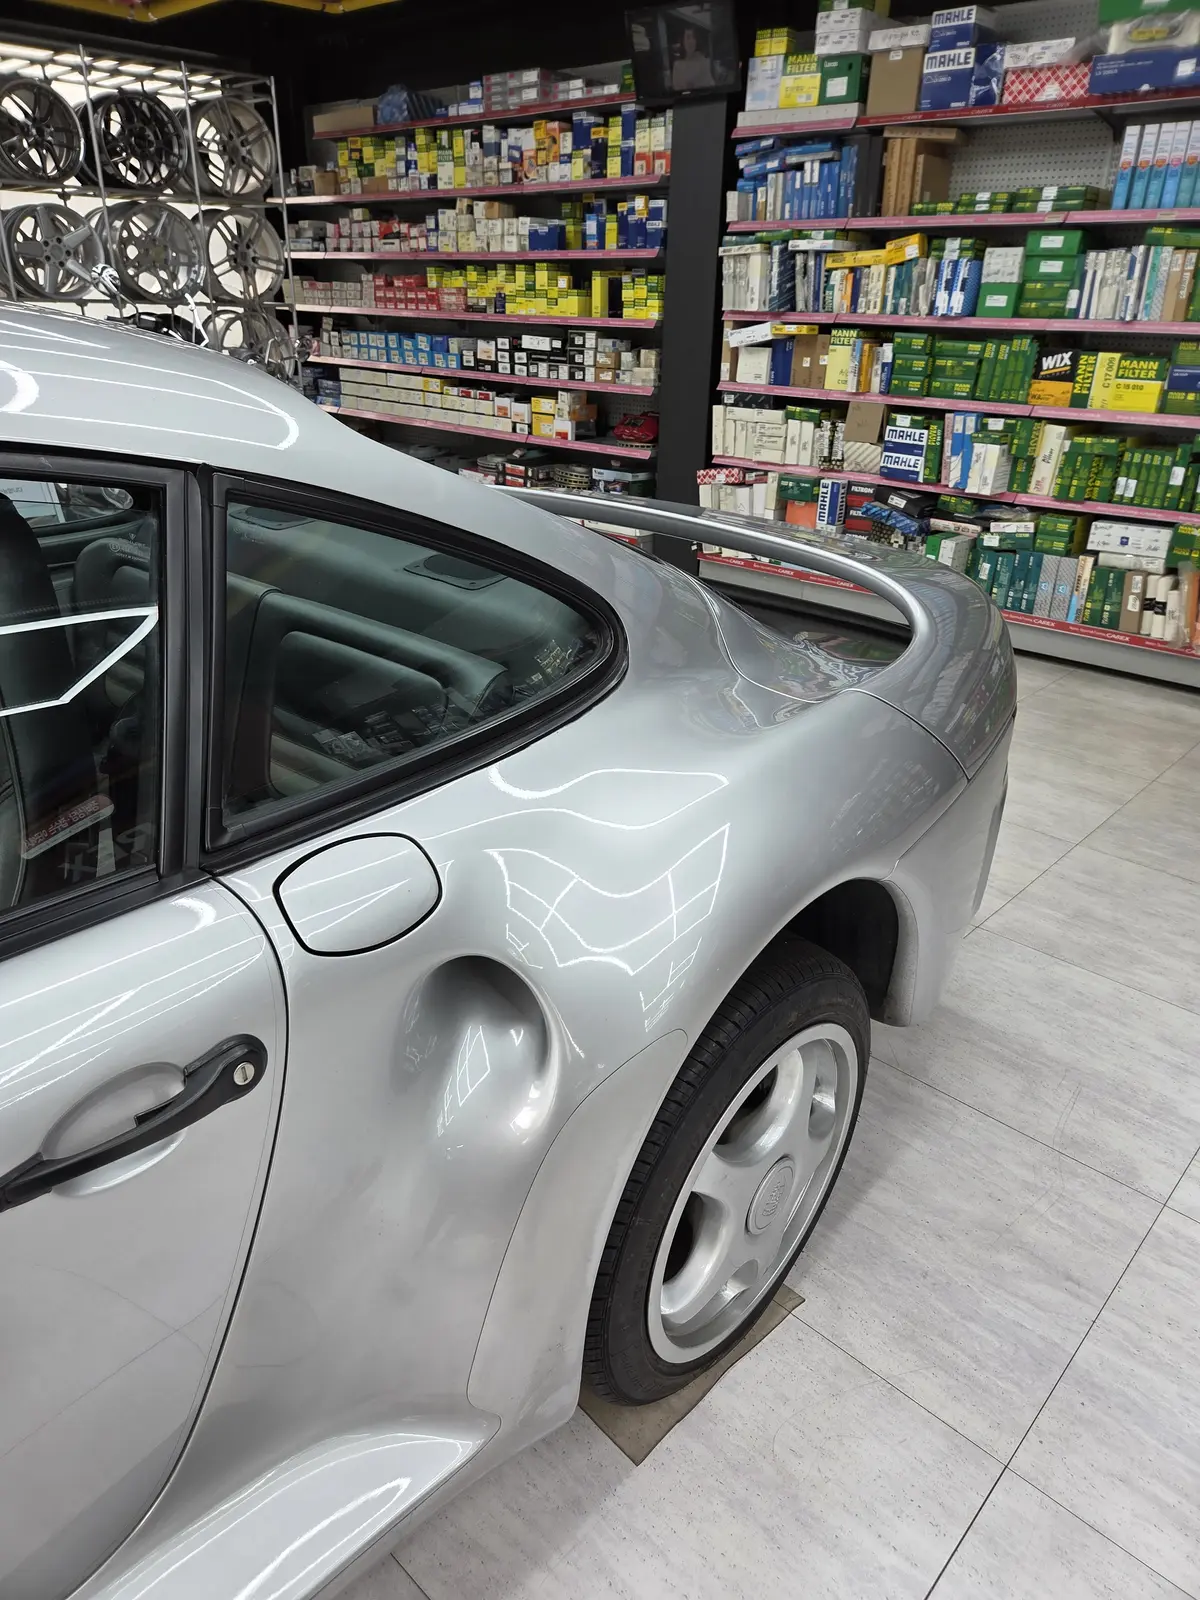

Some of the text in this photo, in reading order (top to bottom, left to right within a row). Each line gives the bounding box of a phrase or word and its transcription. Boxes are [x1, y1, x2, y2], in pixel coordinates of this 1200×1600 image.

[933, 8, 974, 26] MAHLE
[787, 54, 818, 65] MANN
[925, 51, 972, 70] MAHLE
[787, 63, 817, 74] FILTER
[831, 329, 857, 337] MANN
[830, 336, 855, 345] FILTE
[1042, 351, 1073, 370] WIX
[1119, 359, 1159, 370] MANN
[1074, 355, 1088, 393] MANN
[1081, 355, 1097, 393] FILTER
[1104, 371, 1113, 382] 17
[1118, 369, 1156, 379] FILTER
[887, 428, 924, 443] MAHLE
[882, 454, 920, 469] MAHLE
[1042, 454, 1050, 463] Air
[1046, 448, 1054, 464] Filter
[851, 485, 875, 494] FILTRON
[818, 482, 829, 522] MAHLE
[777, 568, 795, 577] CAREX
[836, 580, 854, 588] CAREX
[1033, 618, 1056, 627] CAREX
[1106, 633, 1131, 642] CAREX
